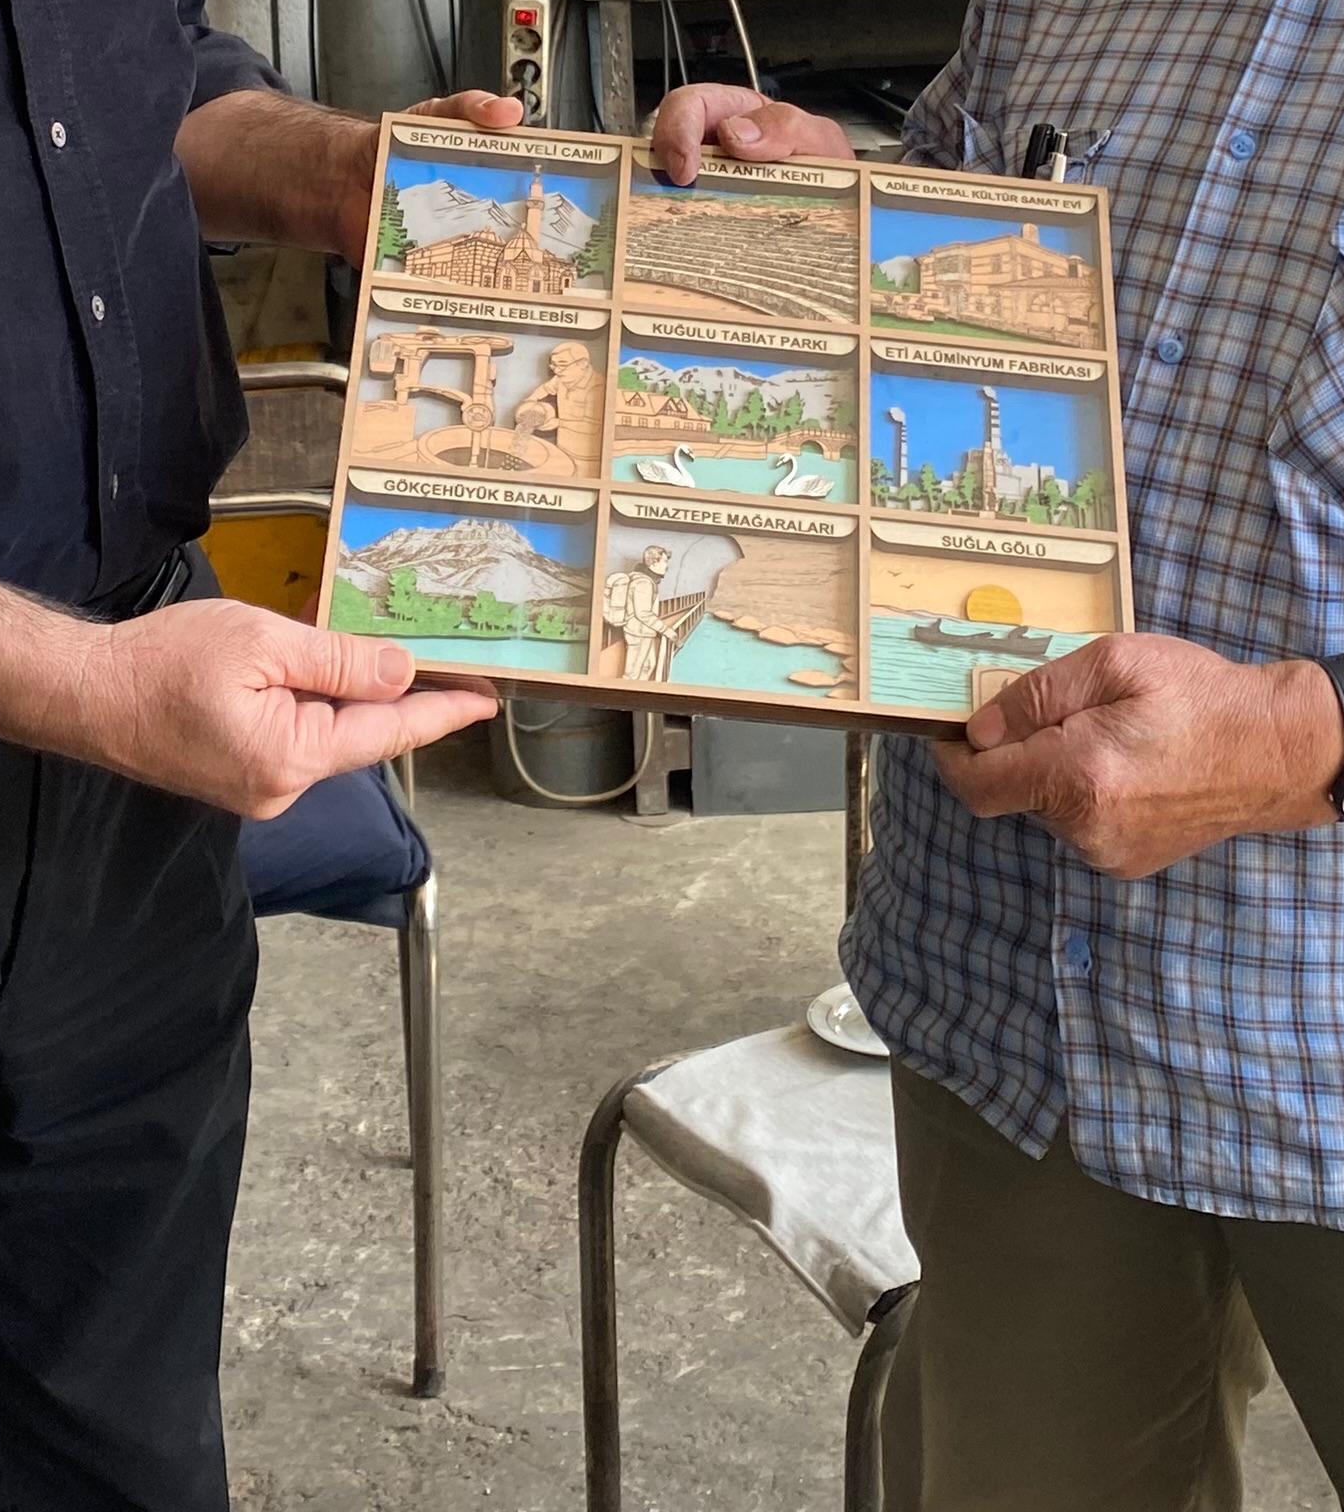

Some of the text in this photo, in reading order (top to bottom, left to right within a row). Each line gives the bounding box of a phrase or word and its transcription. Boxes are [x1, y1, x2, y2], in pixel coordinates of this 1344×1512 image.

[410, 131, 463, 147] SEYYİD
[468, 137, 520, 153] HARUN
[524, 143, 556, 156] VELİ
[699, 162, 825, 184] ADA ANTİK KENTİ
[885, 180, 1082, 210] ADİLE BAYSAL KÜLTÜR SANAT EVİ
[402, 296, 579, 325] SEYDİŞEHİR LEBLEBİSİ
[652, 322, 827, 351] KUĞULU TABİAT PARKI
[885, 346, 1091, 378] ETİ ALÜMİNYUM FABRİKASI
[383, 479, 563, 507] GÖKÇEHÜYÜK BARAJI
[634, 504, 834, 535] TINAZTEPE MAĞARALARI
[942, 534, 1046, 557] SUĞLA GÖLÜ
